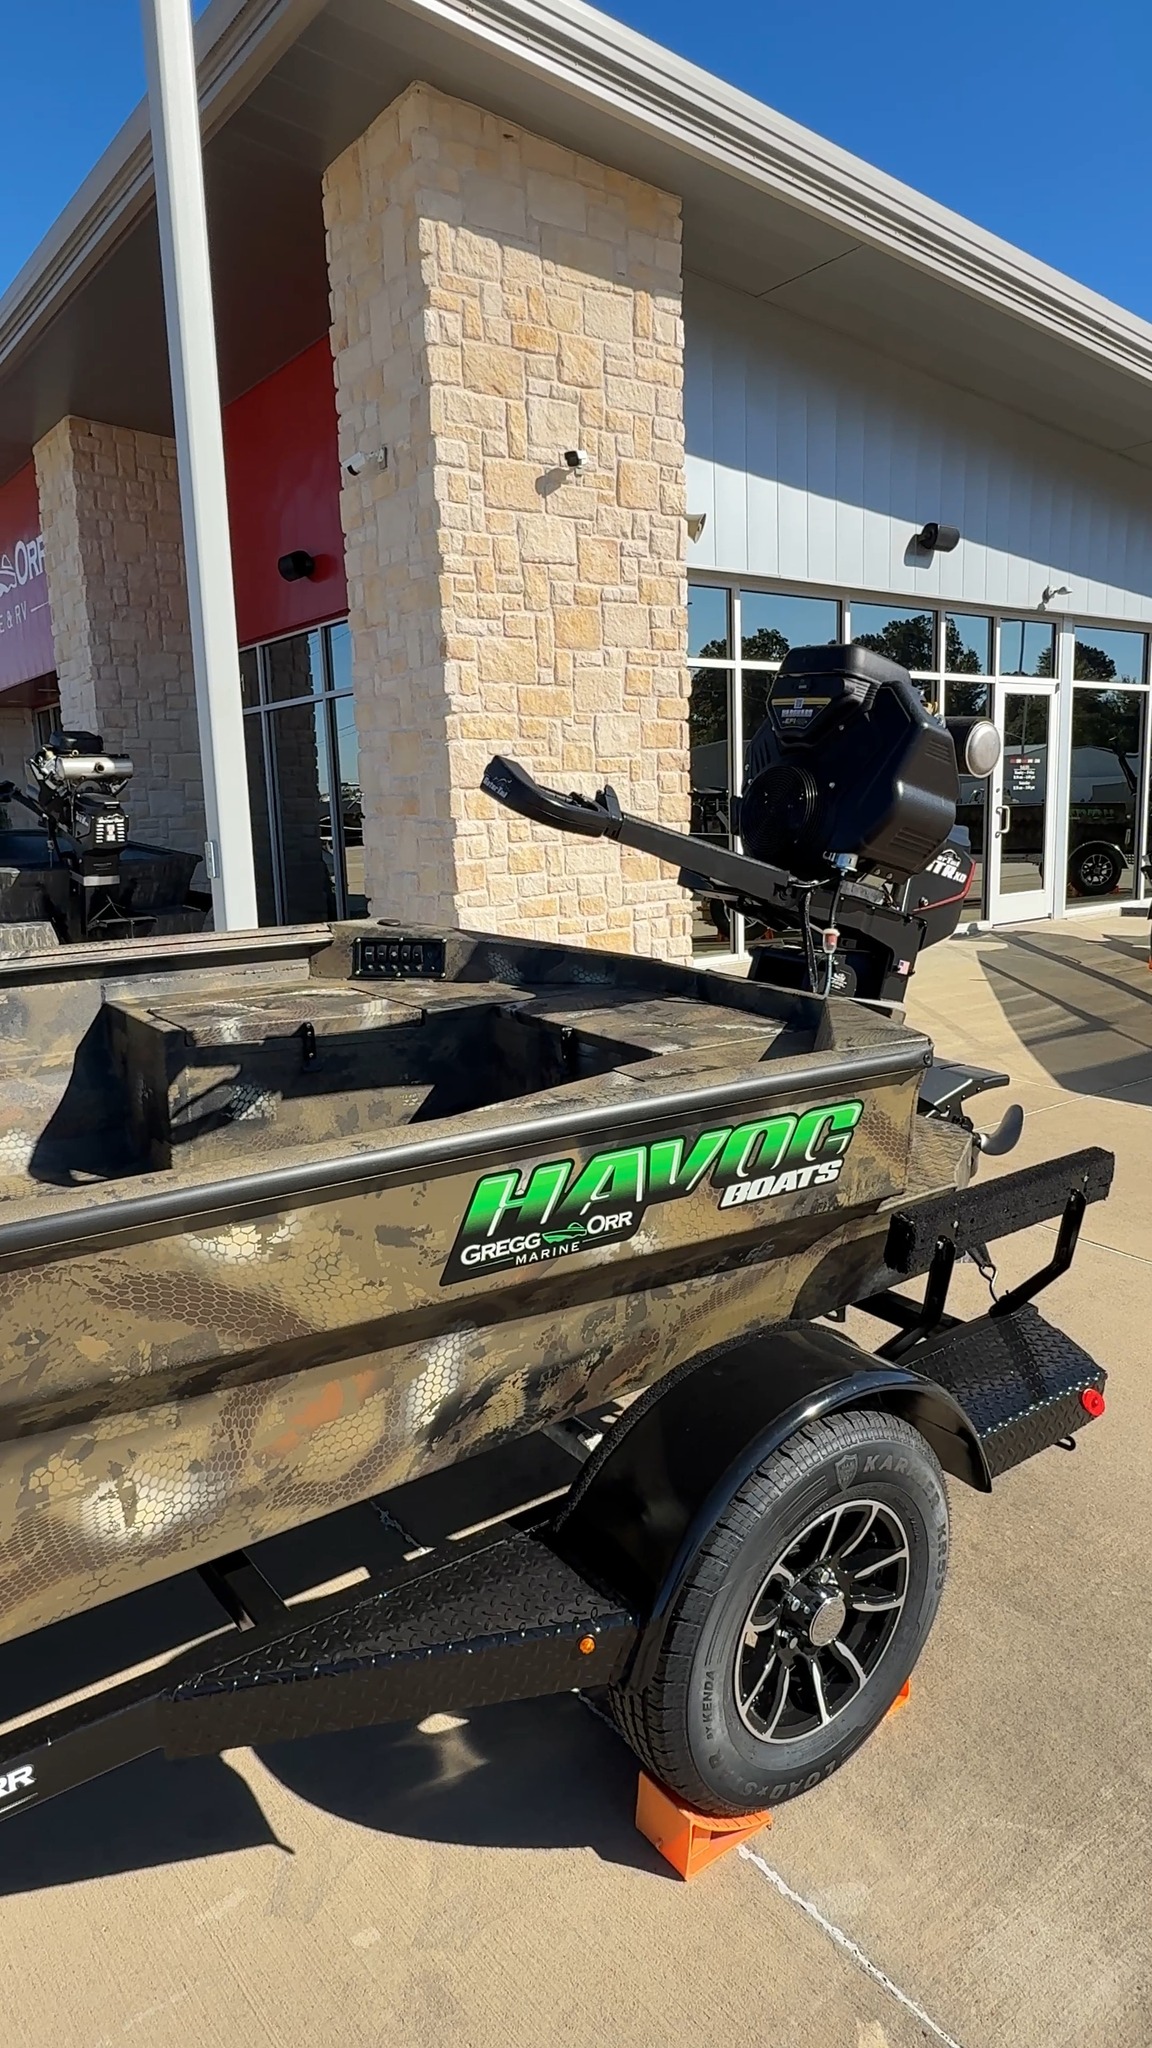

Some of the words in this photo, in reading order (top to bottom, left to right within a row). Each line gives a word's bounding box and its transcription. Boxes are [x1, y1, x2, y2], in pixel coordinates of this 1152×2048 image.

[15, 601, 27, 625] RV
[463, 1100, 863, 1237] HAVOC
[721, 1159, 843, 1209] BOATS
[460, 1232, 542, 1266] GREGG
[586, 1210, 633, 1236] ORR
[515, 1242, 580, 1265] MARINE
[703, 1670, 715, 1723] KENDA
[706, 1728, 714, 1740] BY
